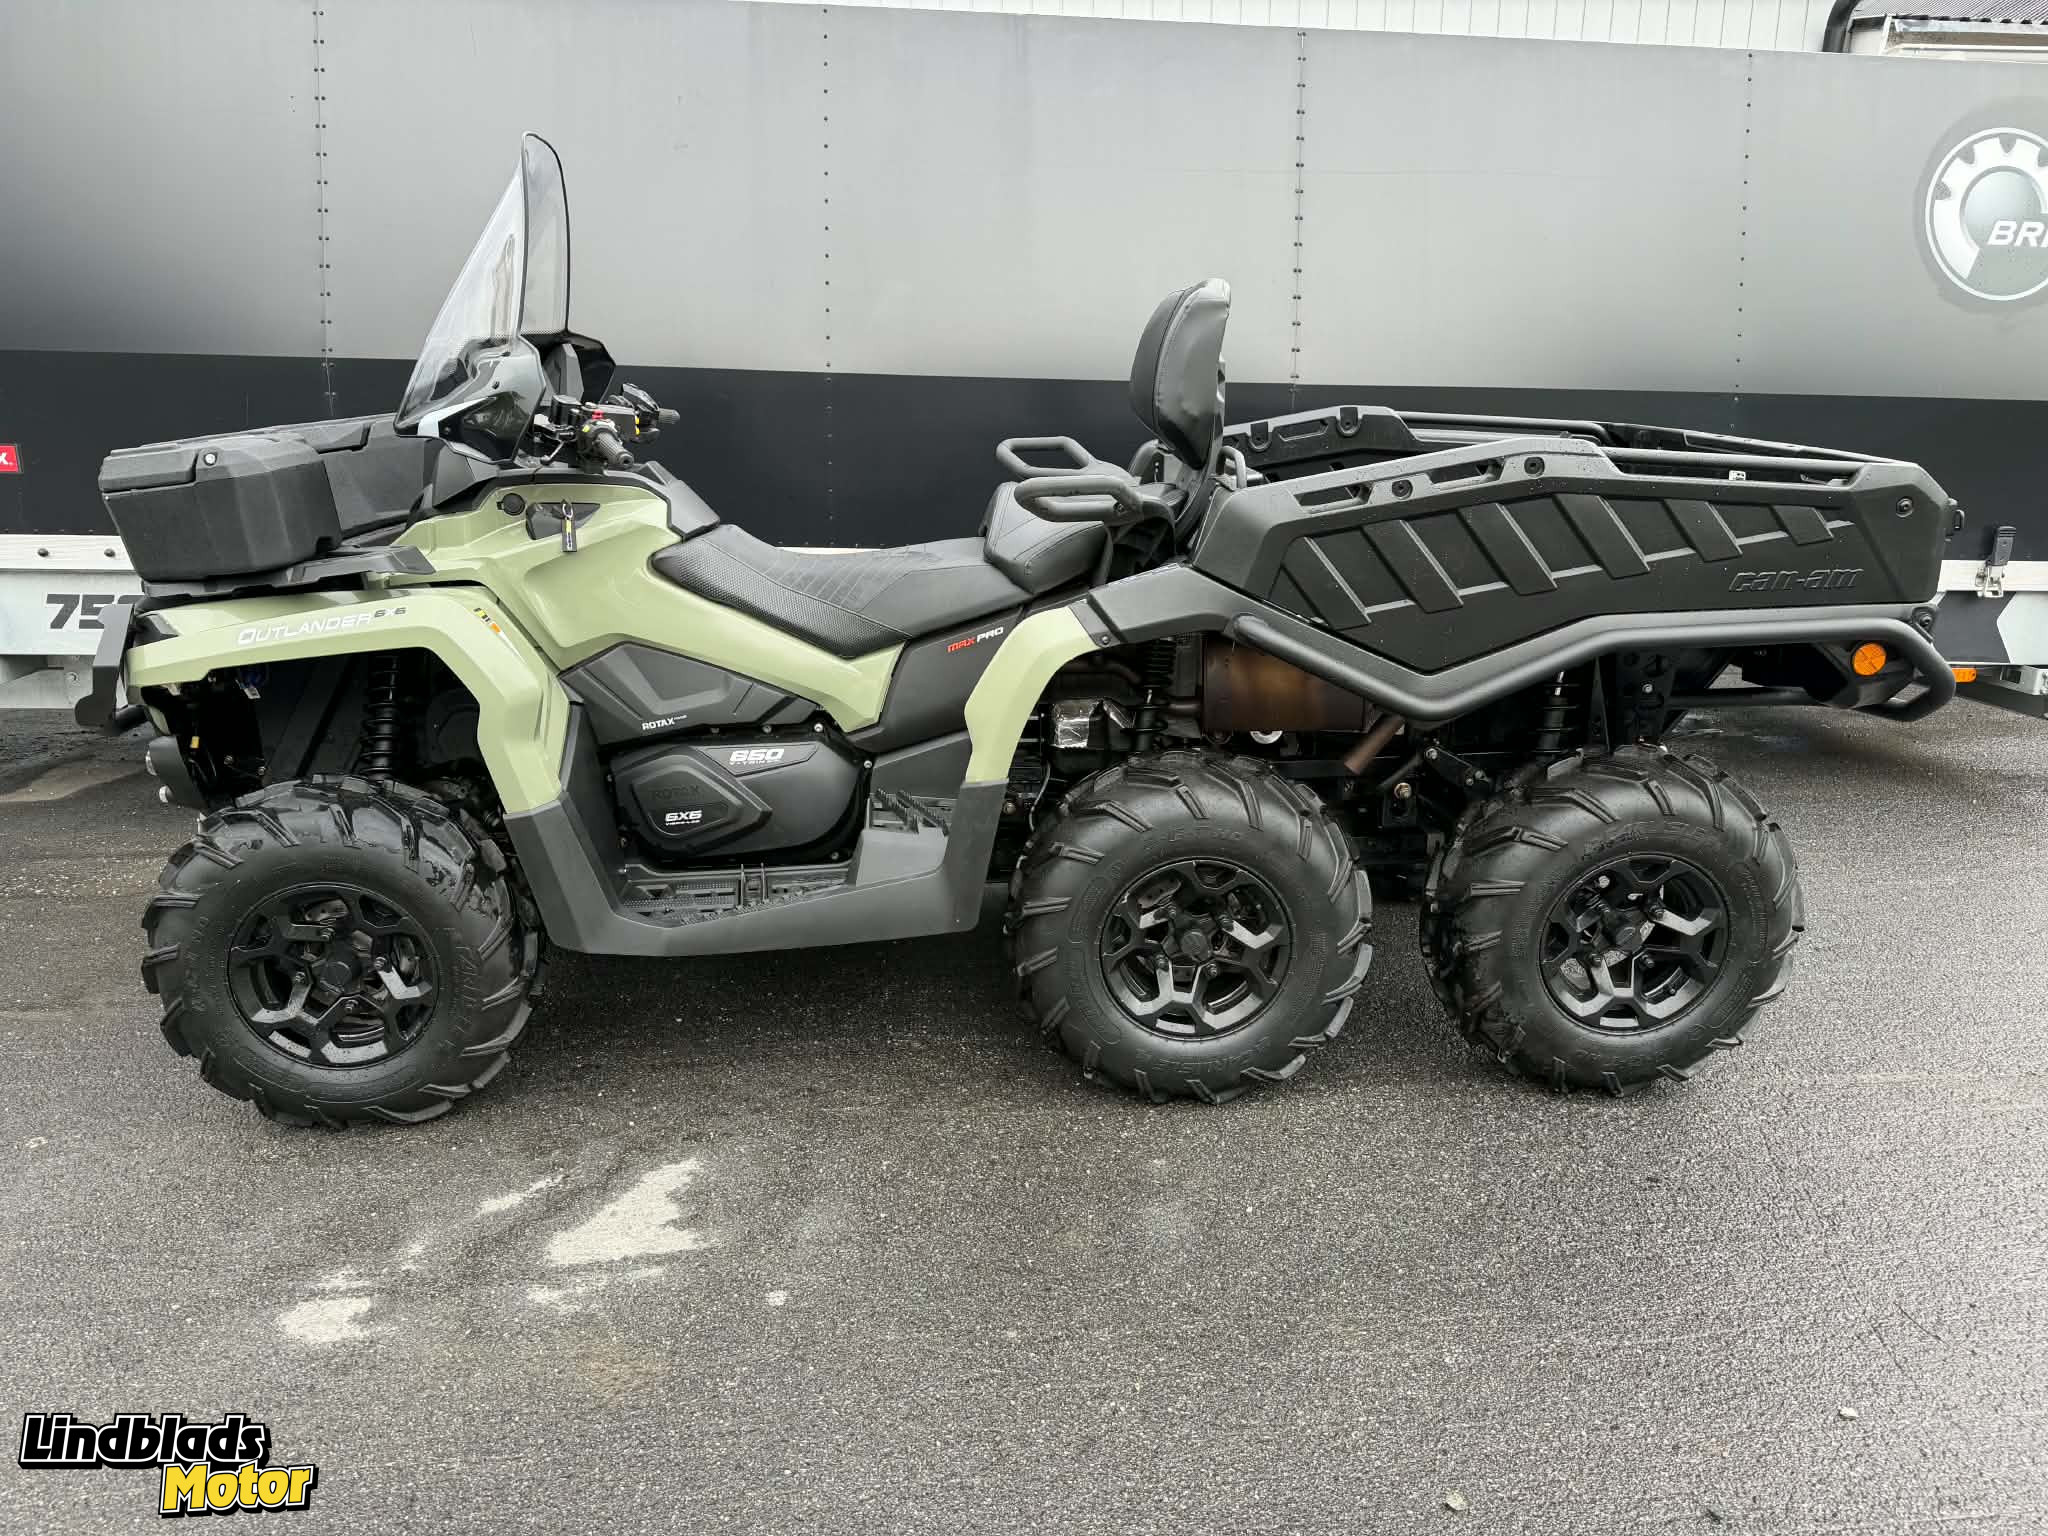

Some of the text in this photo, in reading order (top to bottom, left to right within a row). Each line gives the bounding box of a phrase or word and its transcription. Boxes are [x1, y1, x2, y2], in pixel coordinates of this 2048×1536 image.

[1986, 220, 2048, 248] BR
[46, 593, 143, 629] 75
[947, 626, 1004, 653] MAX PRO
[641, 717, 676, 731] ROTAX
